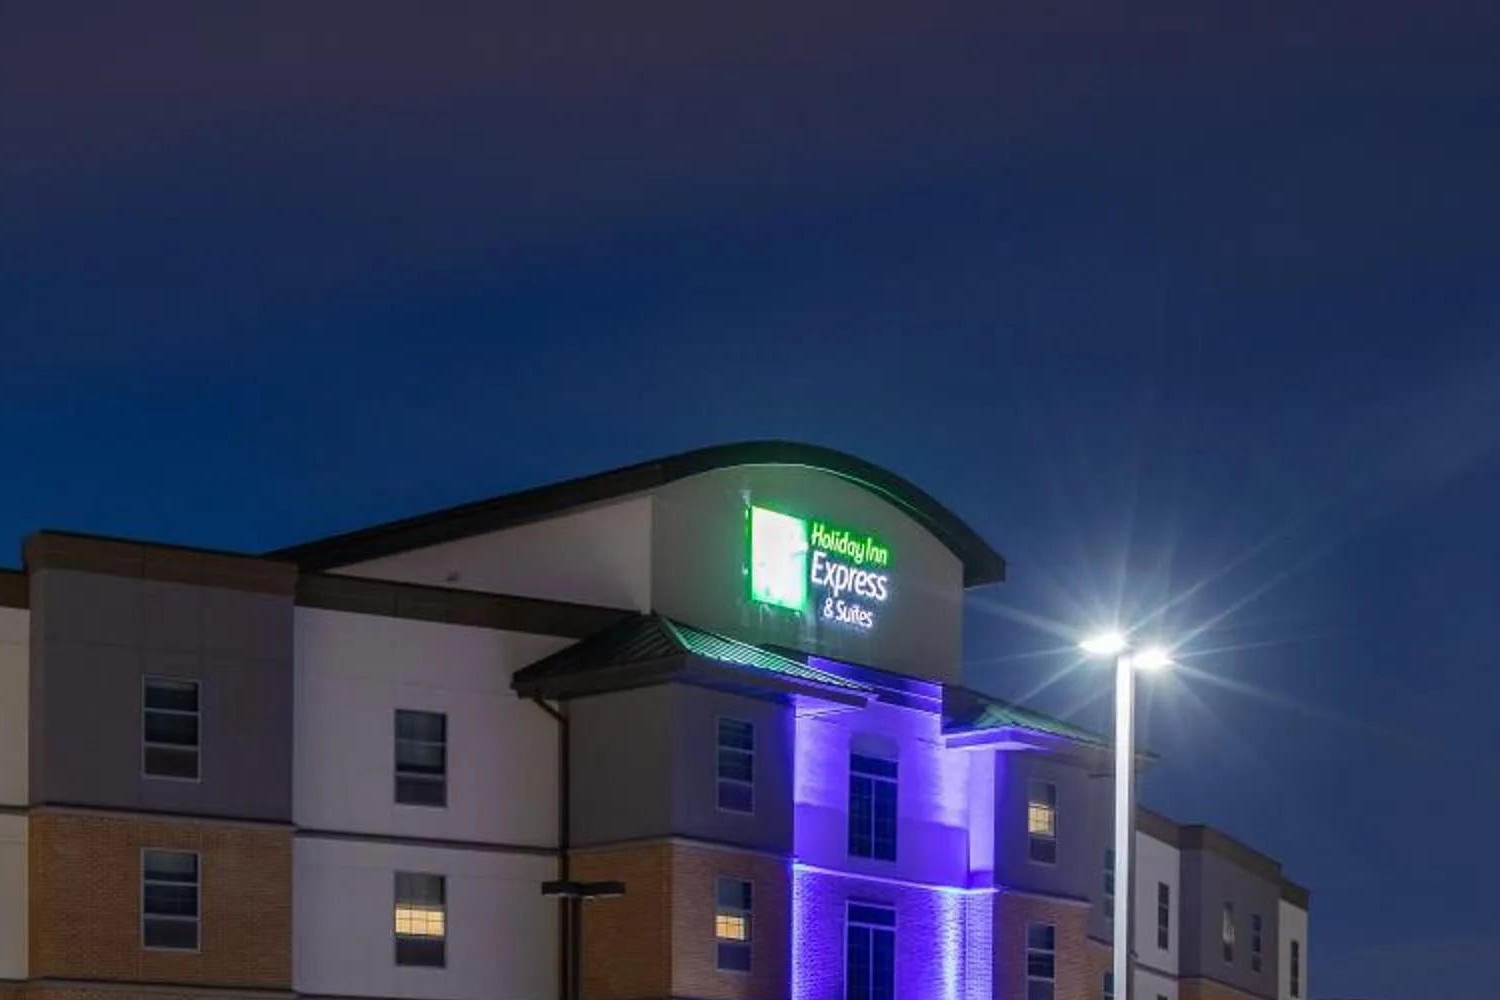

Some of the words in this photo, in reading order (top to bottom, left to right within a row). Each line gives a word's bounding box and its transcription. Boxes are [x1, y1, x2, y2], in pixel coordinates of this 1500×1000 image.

[811, 523, 864, 564] Holiday
[865, 537, 888, 566] Inn
[811, 550, 888, 601] Express
[823, 597, 833, 618] &
[836, 600, 873, 628] Suites
